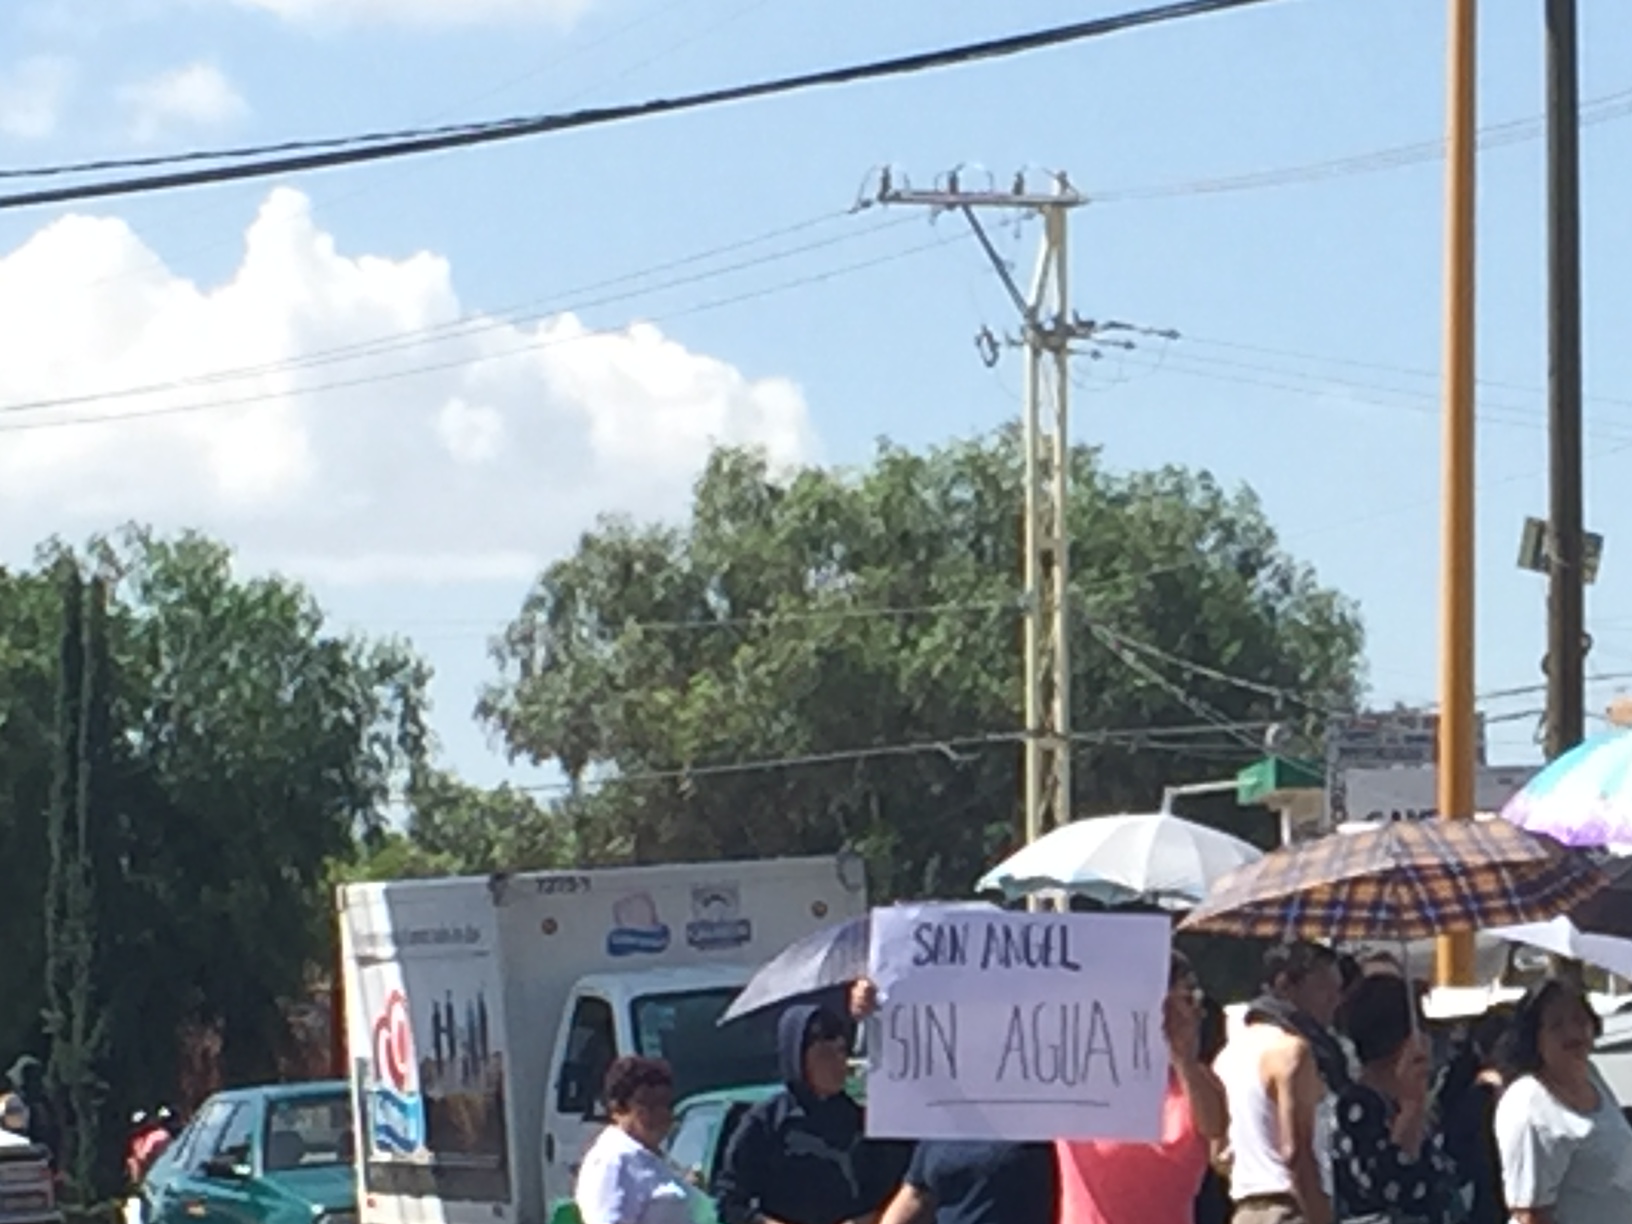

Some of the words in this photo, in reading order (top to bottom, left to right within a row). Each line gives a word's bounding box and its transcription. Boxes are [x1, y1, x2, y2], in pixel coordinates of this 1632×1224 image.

[912, 921, 969, 967] SAN
[979, 922, 1082, 972] ANGEL
[888, 1001, 957, 1081] SIN
[997, 1000, 1121, 1088] AGUA
